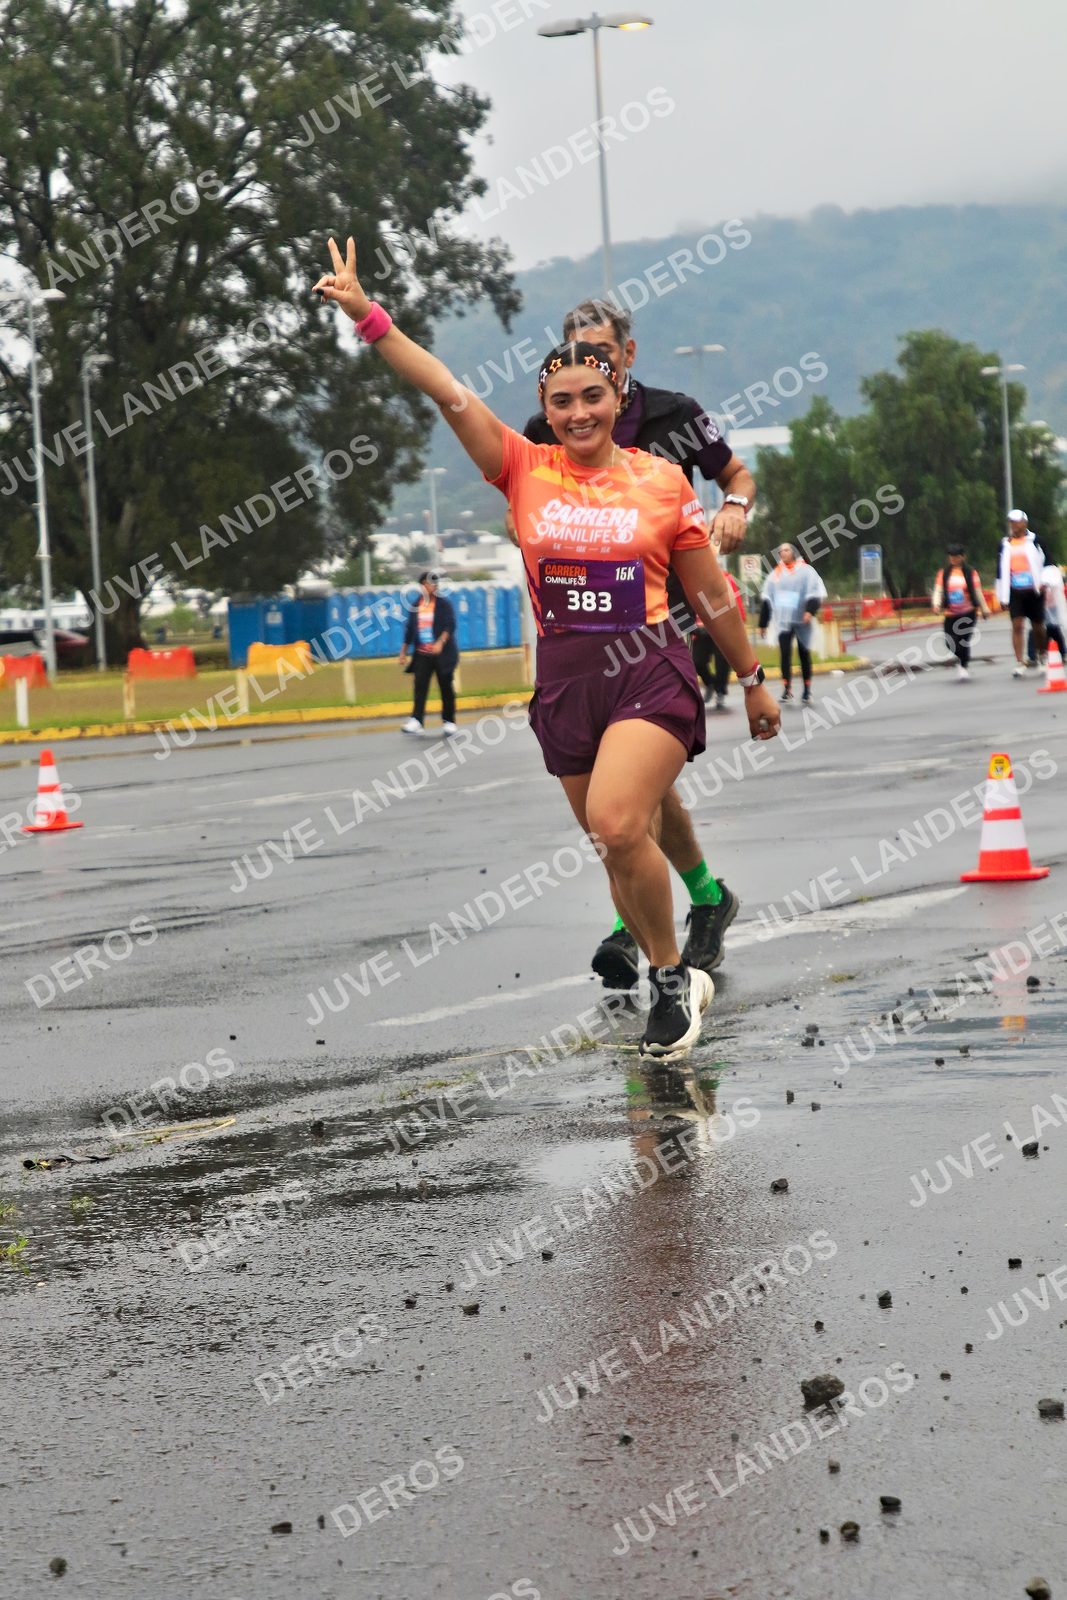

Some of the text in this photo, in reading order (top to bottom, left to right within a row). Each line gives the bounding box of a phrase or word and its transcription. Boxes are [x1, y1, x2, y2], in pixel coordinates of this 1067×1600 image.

[542, 498, 639, 531] CARRERA
[536, 521, 612, 543] OMNILIFE
[545, 564, 587, 577] CARRERA
[615, 566, 636, 581] 15K
[545, 576, 577, 586] OMNILIFE
[567, 590, 612, 612] 383
